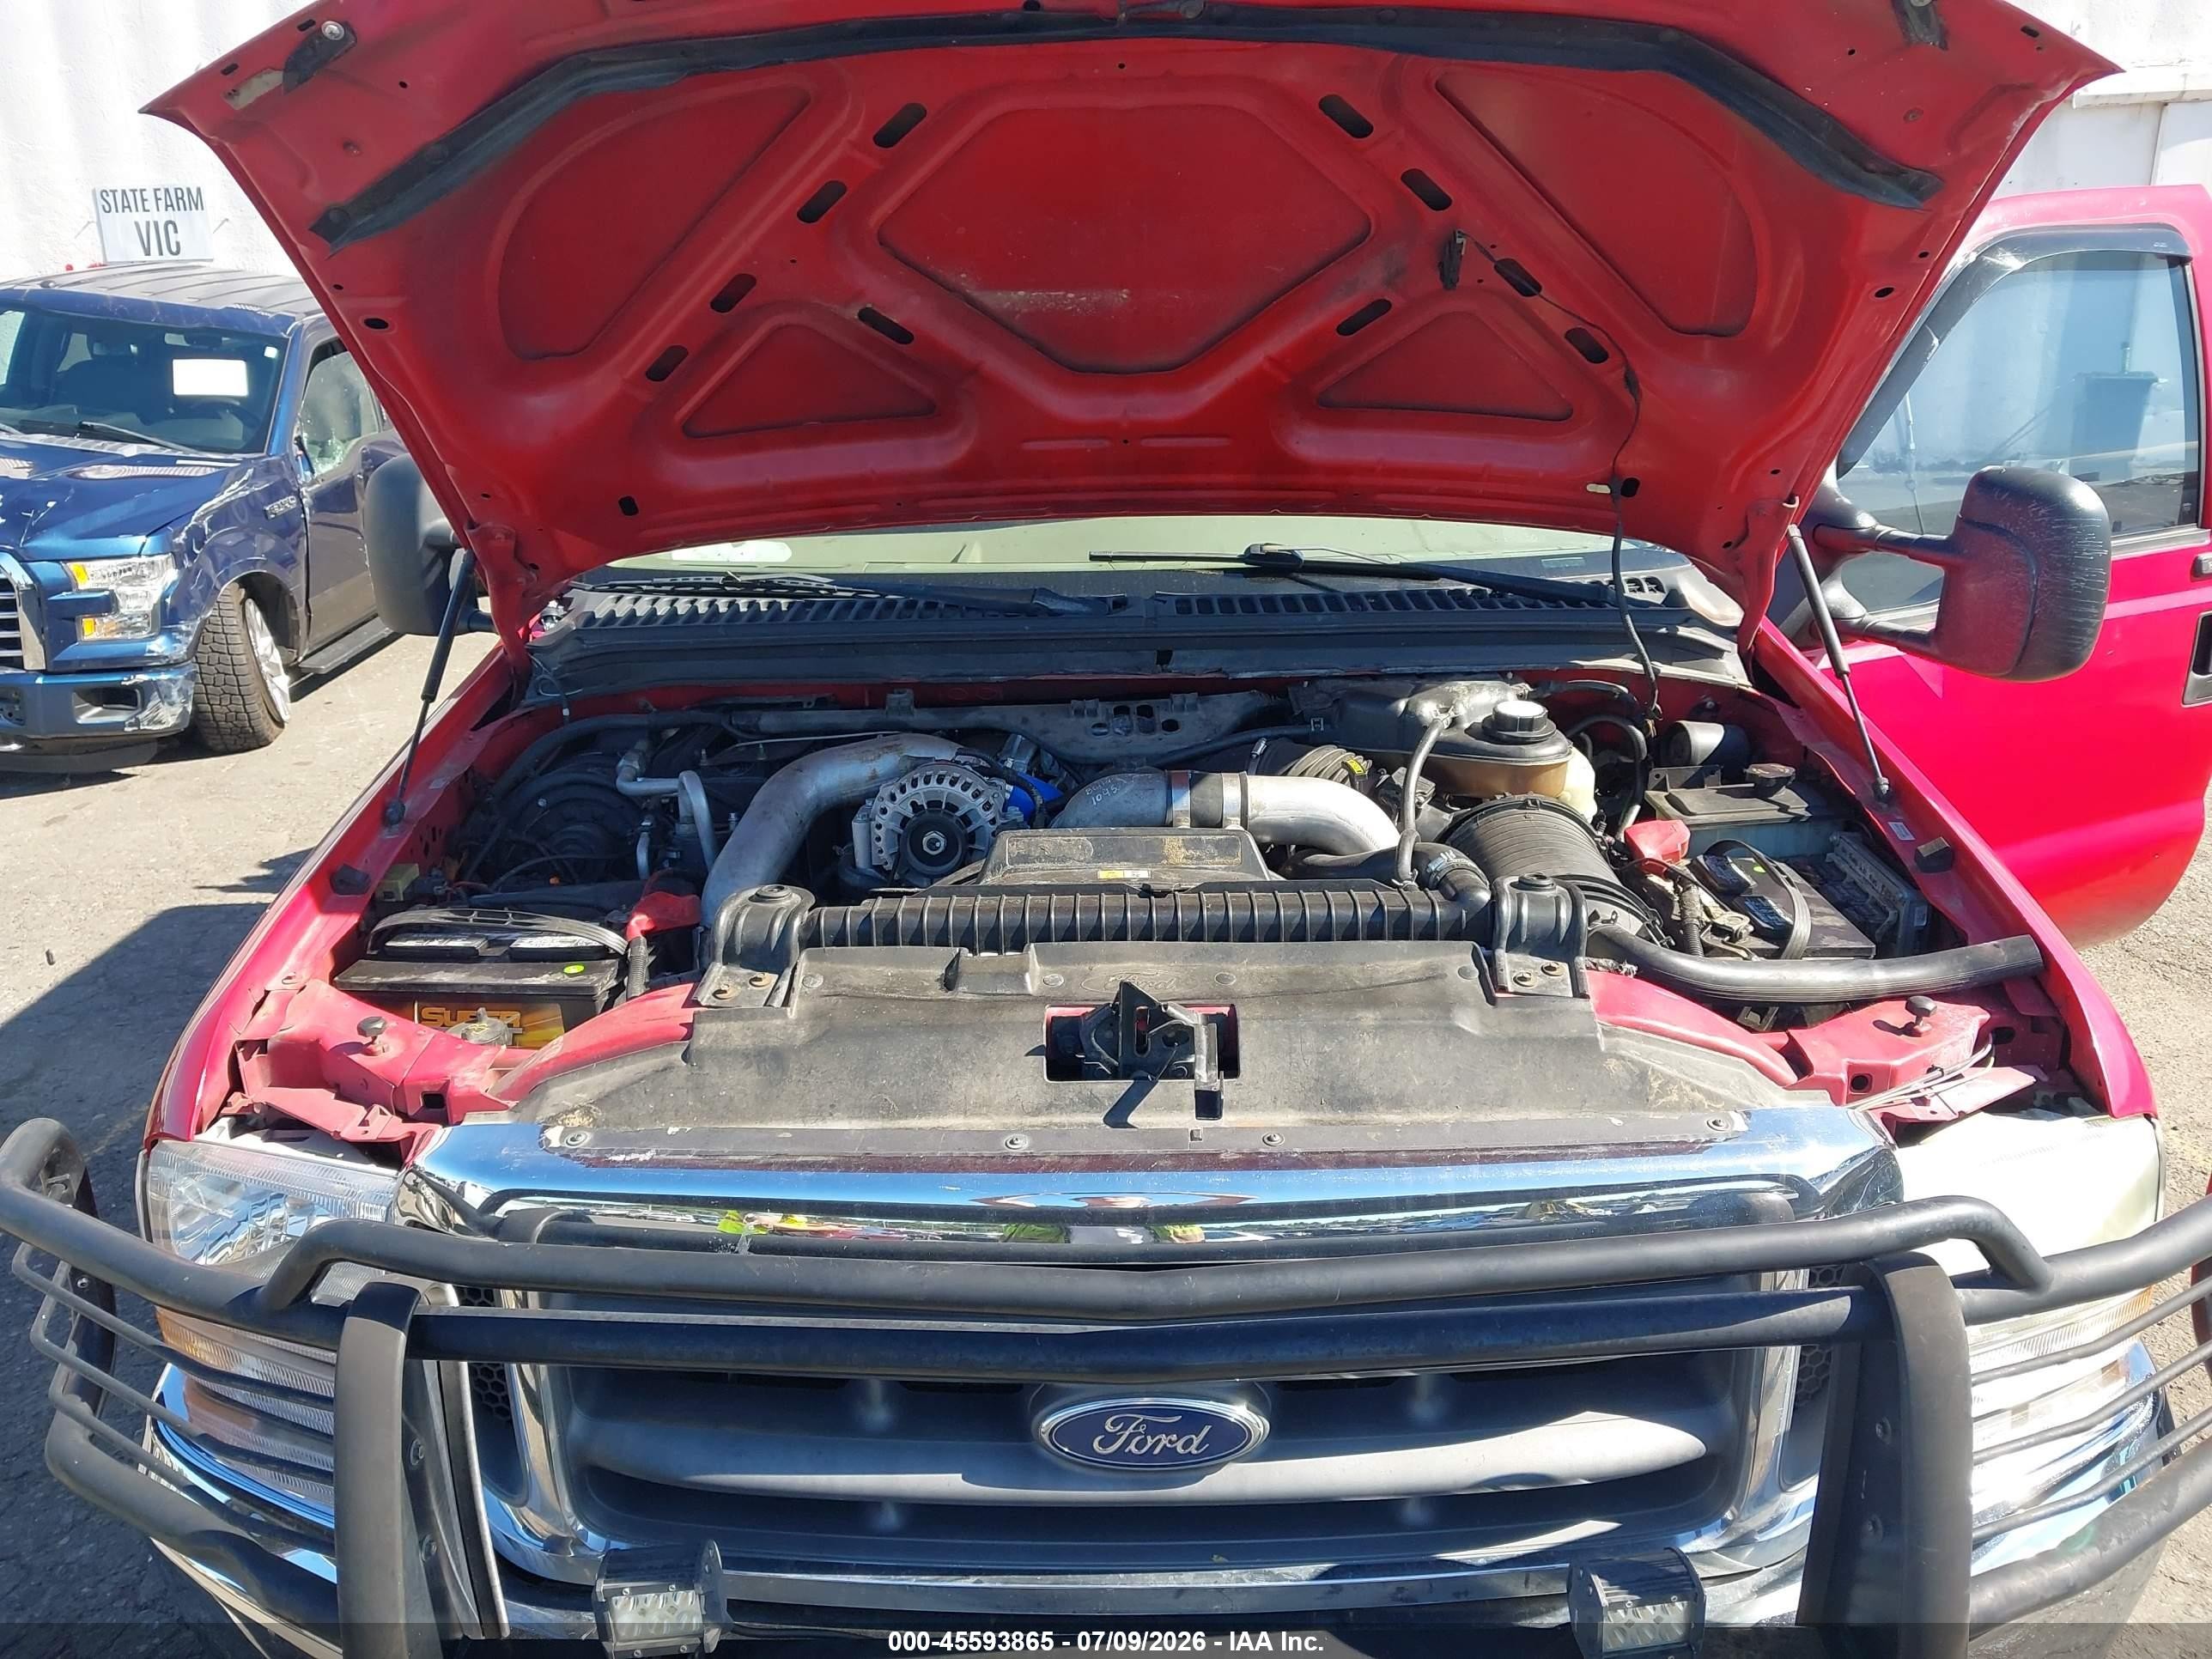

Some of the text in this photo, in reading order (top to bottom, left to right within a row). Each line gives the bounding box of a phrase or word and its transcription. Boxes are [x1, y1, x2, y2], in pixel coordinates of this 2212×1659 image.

[100, 186, 204, 213] STATE FARM
[134, 220, 181, 257] VIC
[1093, 1414, 1212, 1455] Ford
